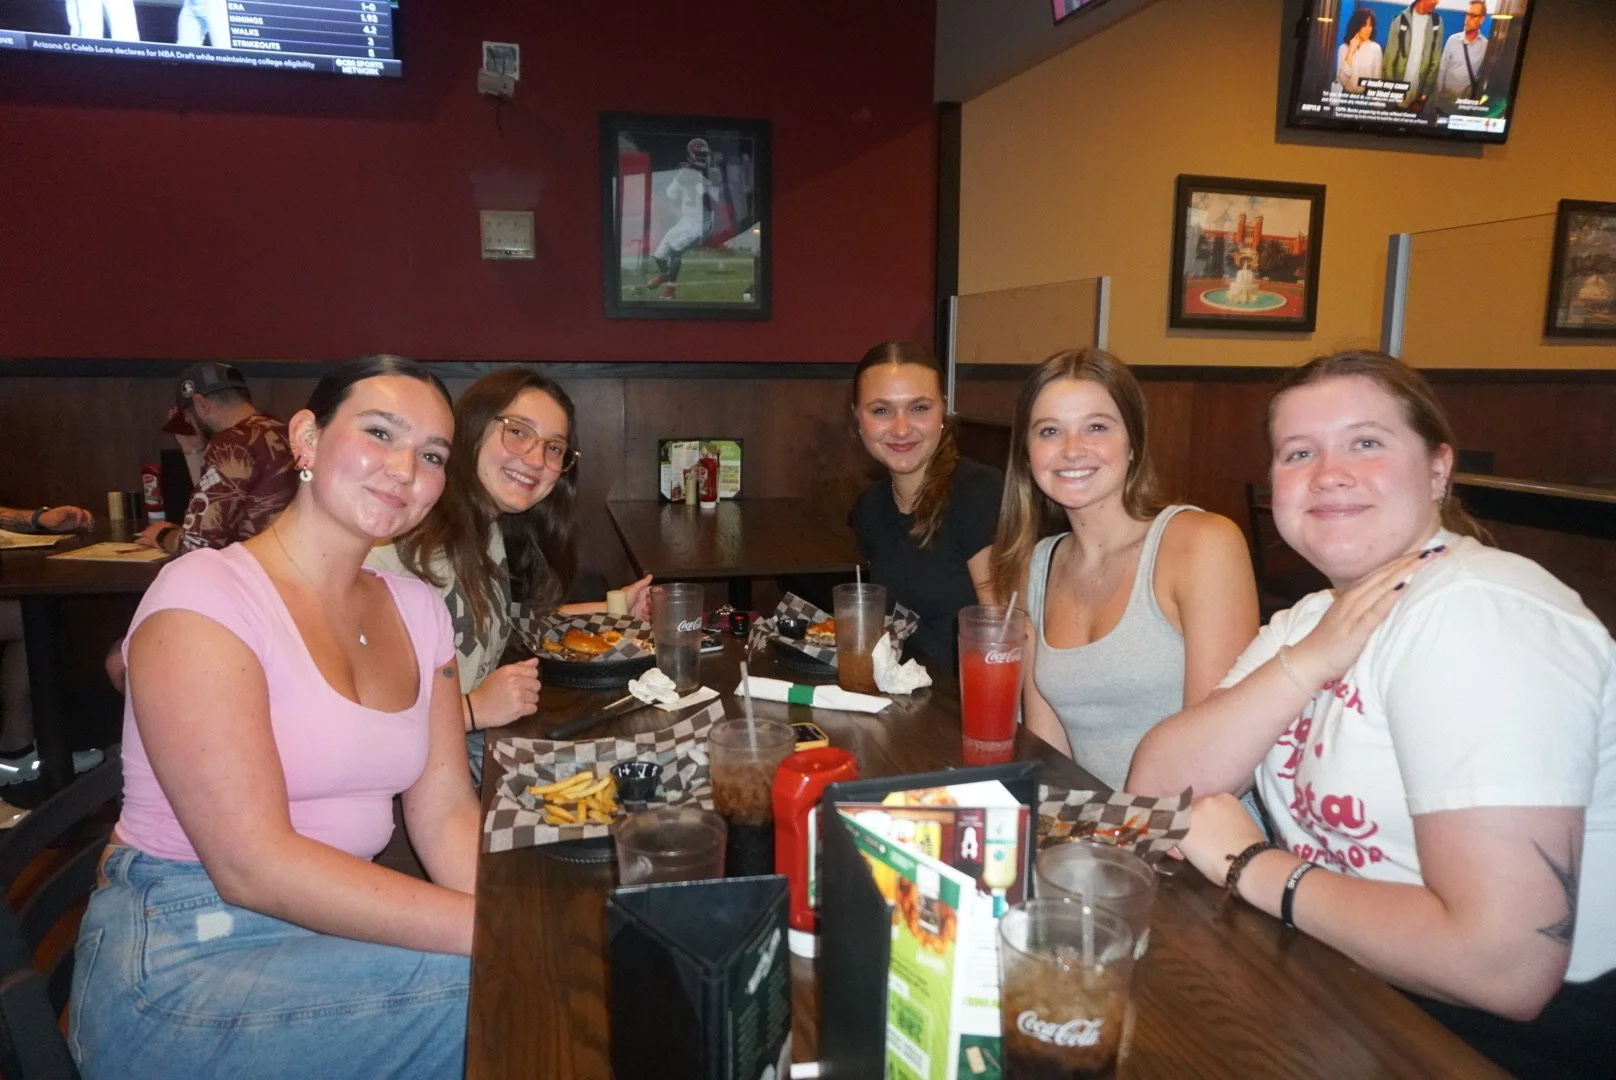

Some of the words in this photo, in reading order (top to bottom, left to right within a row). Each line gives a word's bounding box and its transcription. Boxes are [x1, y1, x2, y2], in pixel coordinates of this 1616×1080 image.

[229, 15, 264, 25] INNINGS
[231, 27, 260, 36] WALKS
[232, 39, 281, 50] STRIKEOUTS
[33, 40, 63, 50] Arizona
[72, 43, 94, 53] Caleb
[95, 45, 113, 54] Love
[115, 46, 146, 57] declares
[146, 48, 157, 58] for
[158, 50, 175, 59] NBA
[176, 50, 195, 60] Draft
[196, 52, 215, 62] while
[216, 55, 257, 66] maintaining
[258, 57, 284, 68] college
[284, 59, 316, 70] eligibility
[342, 66, 379, 76] NETWORK
[1016, 1009, 1105, 1047] Coca-Cola
